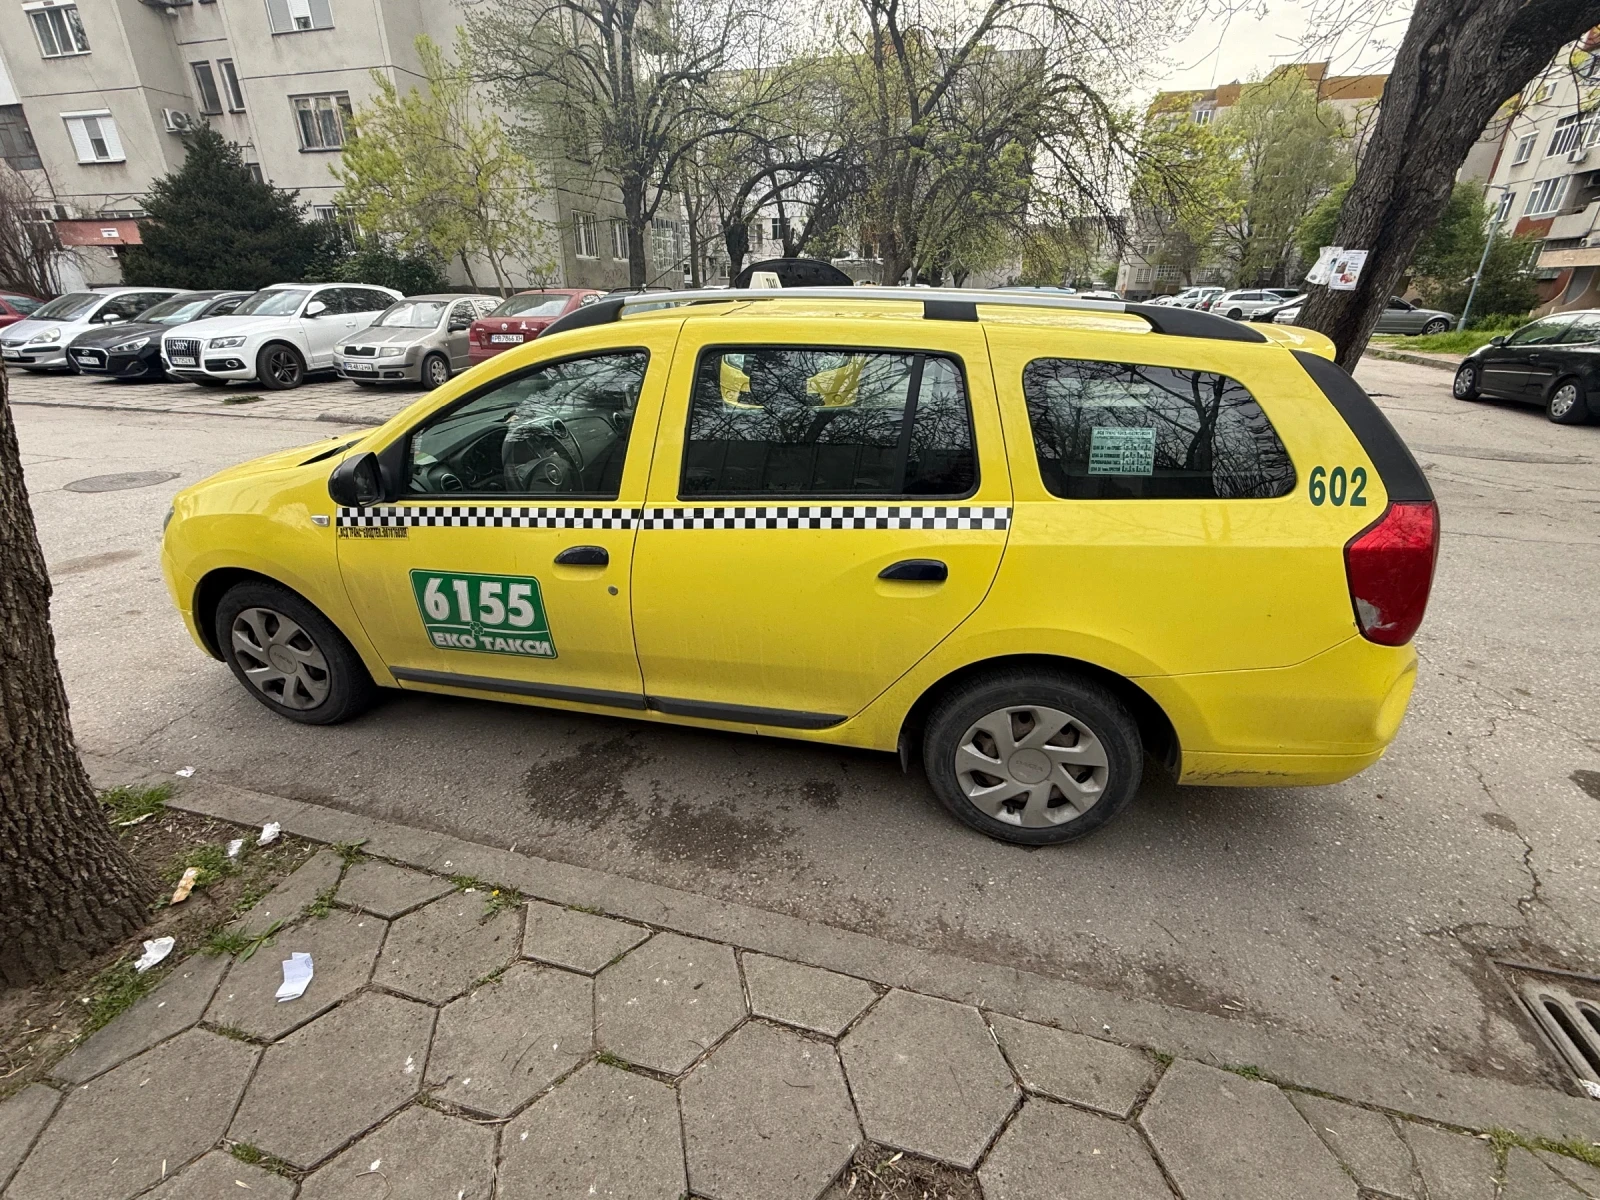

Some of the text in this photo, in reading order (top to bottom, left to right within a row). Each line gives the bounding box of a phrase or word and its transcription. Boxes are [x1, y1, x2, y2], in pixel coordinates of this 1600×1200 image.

[1308, 465, 1367, 507] 602
[422, 577, 536, 628] 6155
[431, 631, 553, 656] ЕКО ТАКСИ
